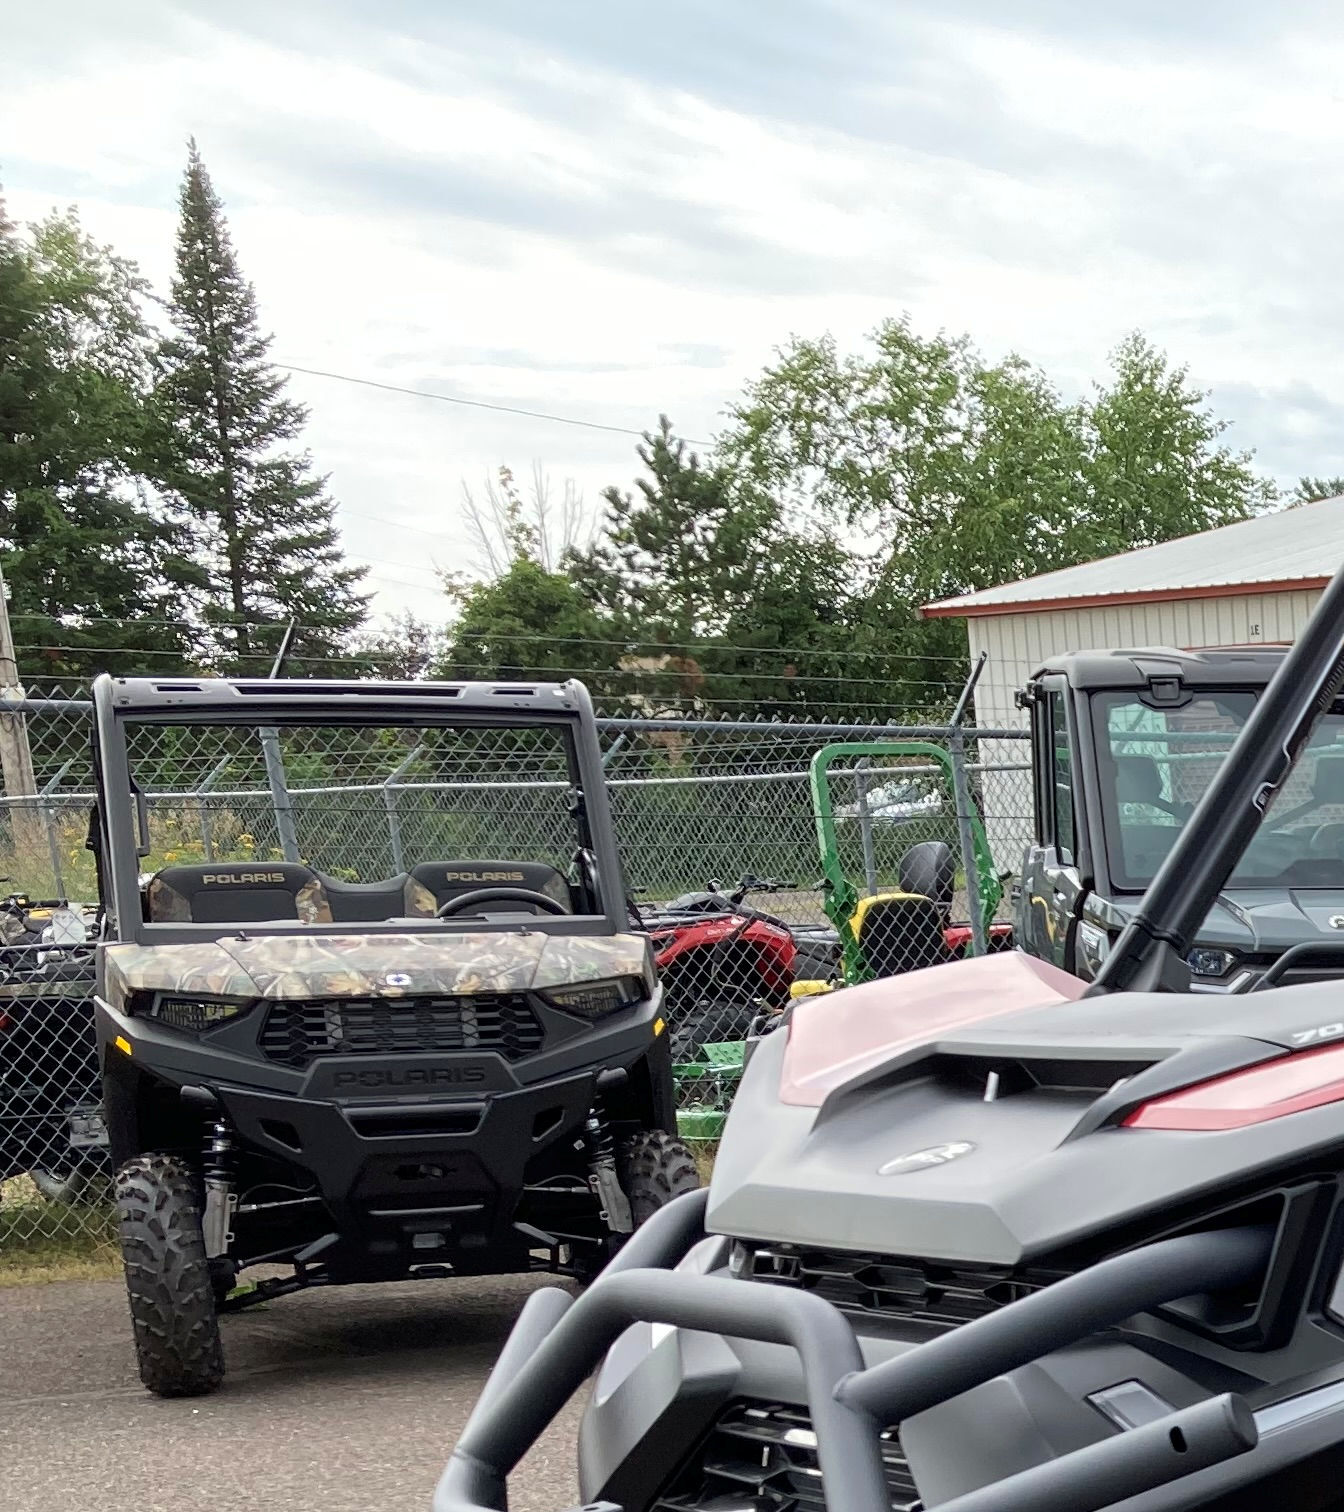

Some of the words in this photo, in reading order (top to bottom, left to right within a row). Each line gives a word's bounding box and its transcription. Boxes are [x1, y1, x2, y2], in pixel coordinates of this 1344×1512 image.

[1250, 624, 1260, 636] 1E
[202, 873, 285, 885] POLARIS
[446, 872, 524, 881] POLARIS
[334, 1067, 485, 1088] POLARIS
